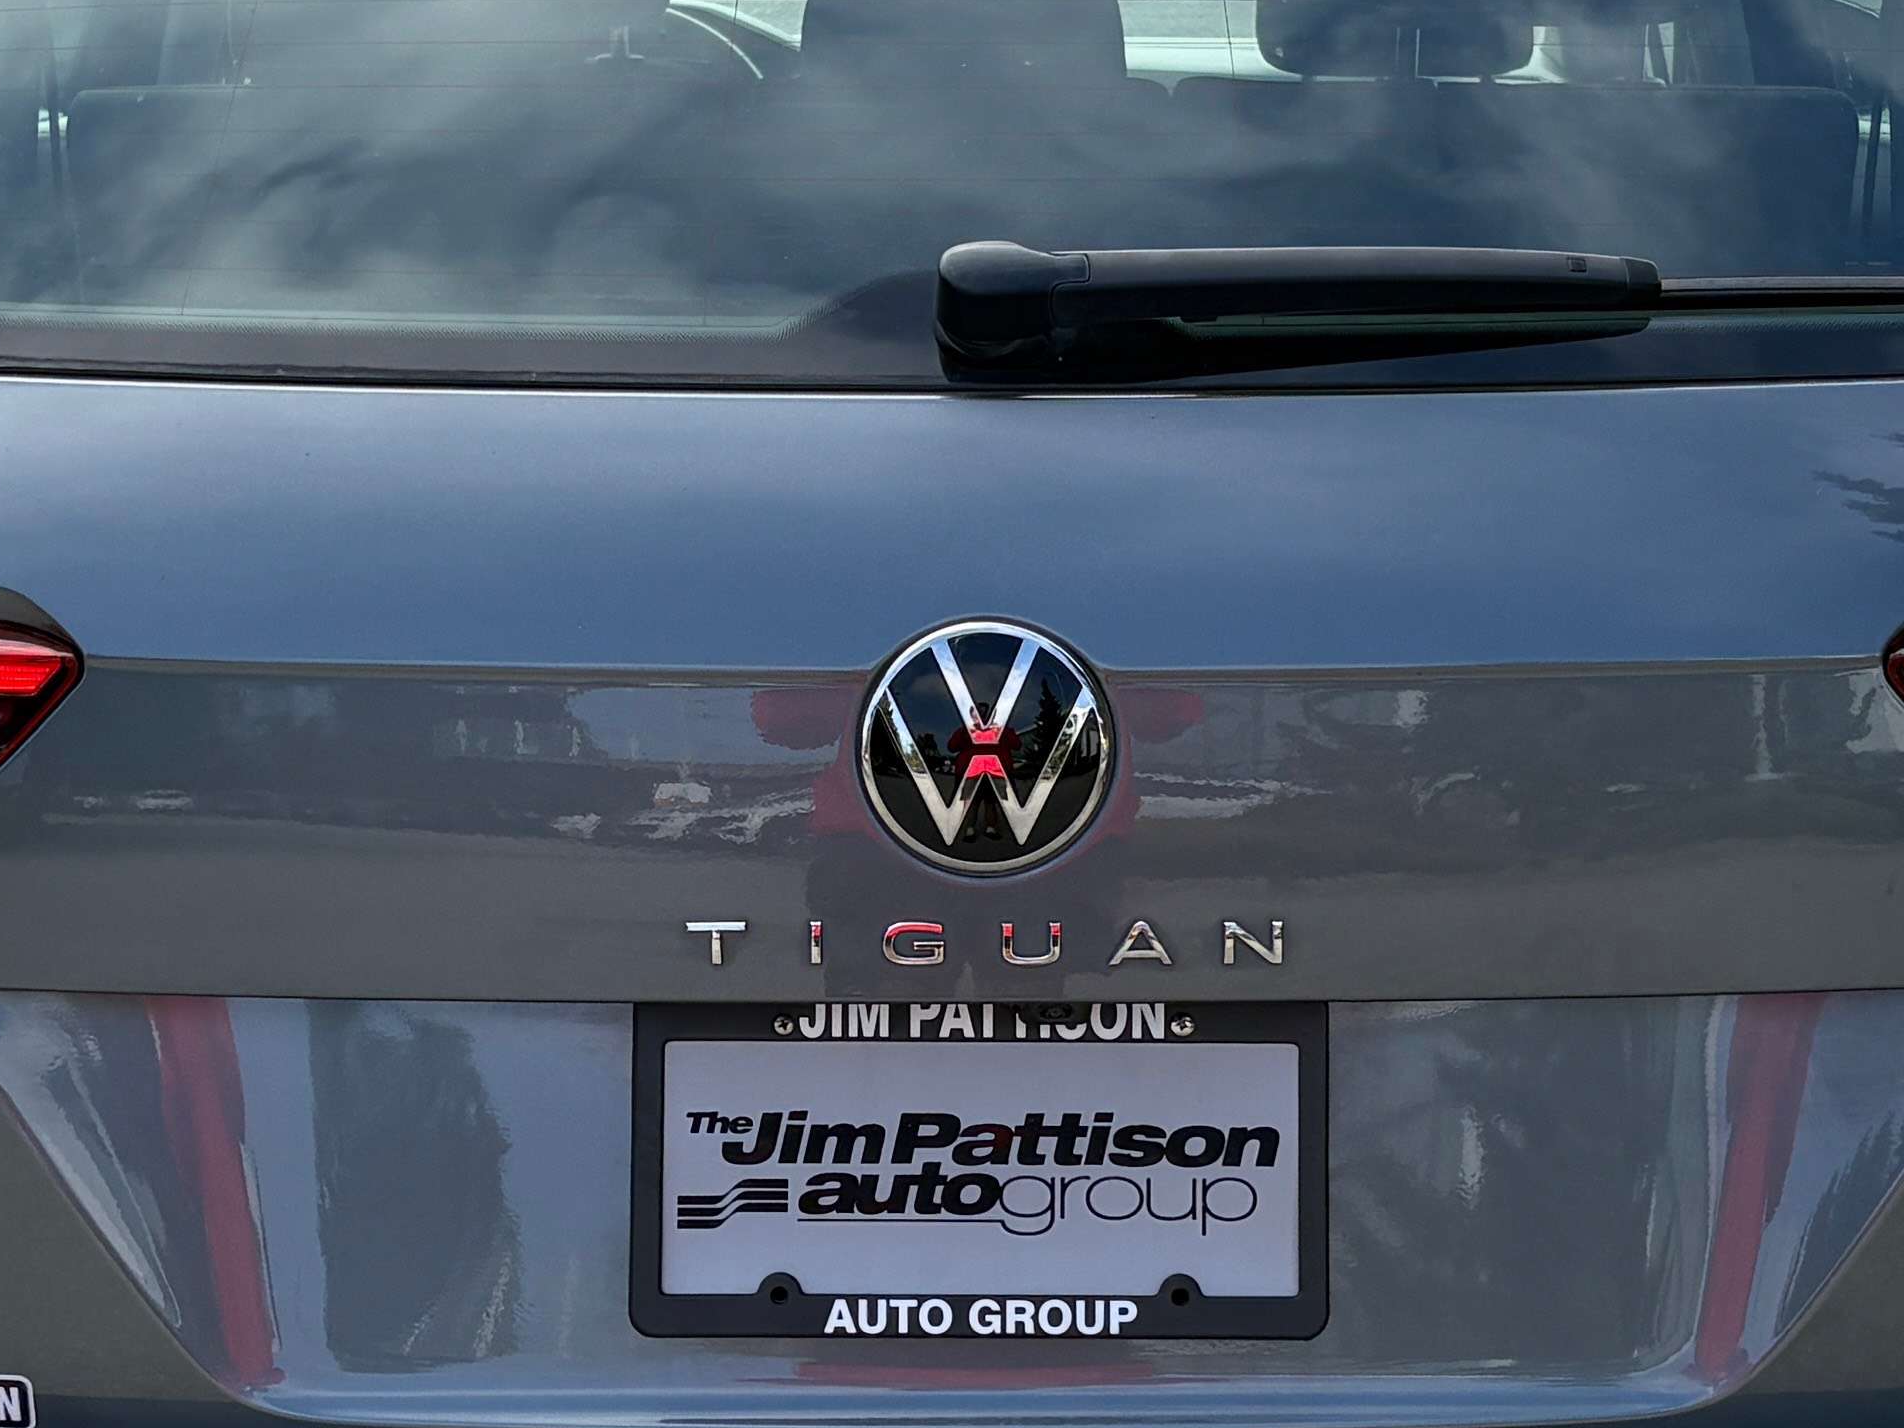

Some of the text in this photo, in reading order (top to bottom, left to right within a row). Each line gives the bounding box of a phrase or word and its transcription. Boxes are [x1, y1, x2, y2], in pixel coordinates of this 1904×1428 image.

[686, 920, 1286, 966] TIGUAN
[799, 1003, 890, 1039] JIM
[686, 1110, 1280, 1168] The Jim Pattison
[824, 1299, 1138, 1335] AUTO GROUP
